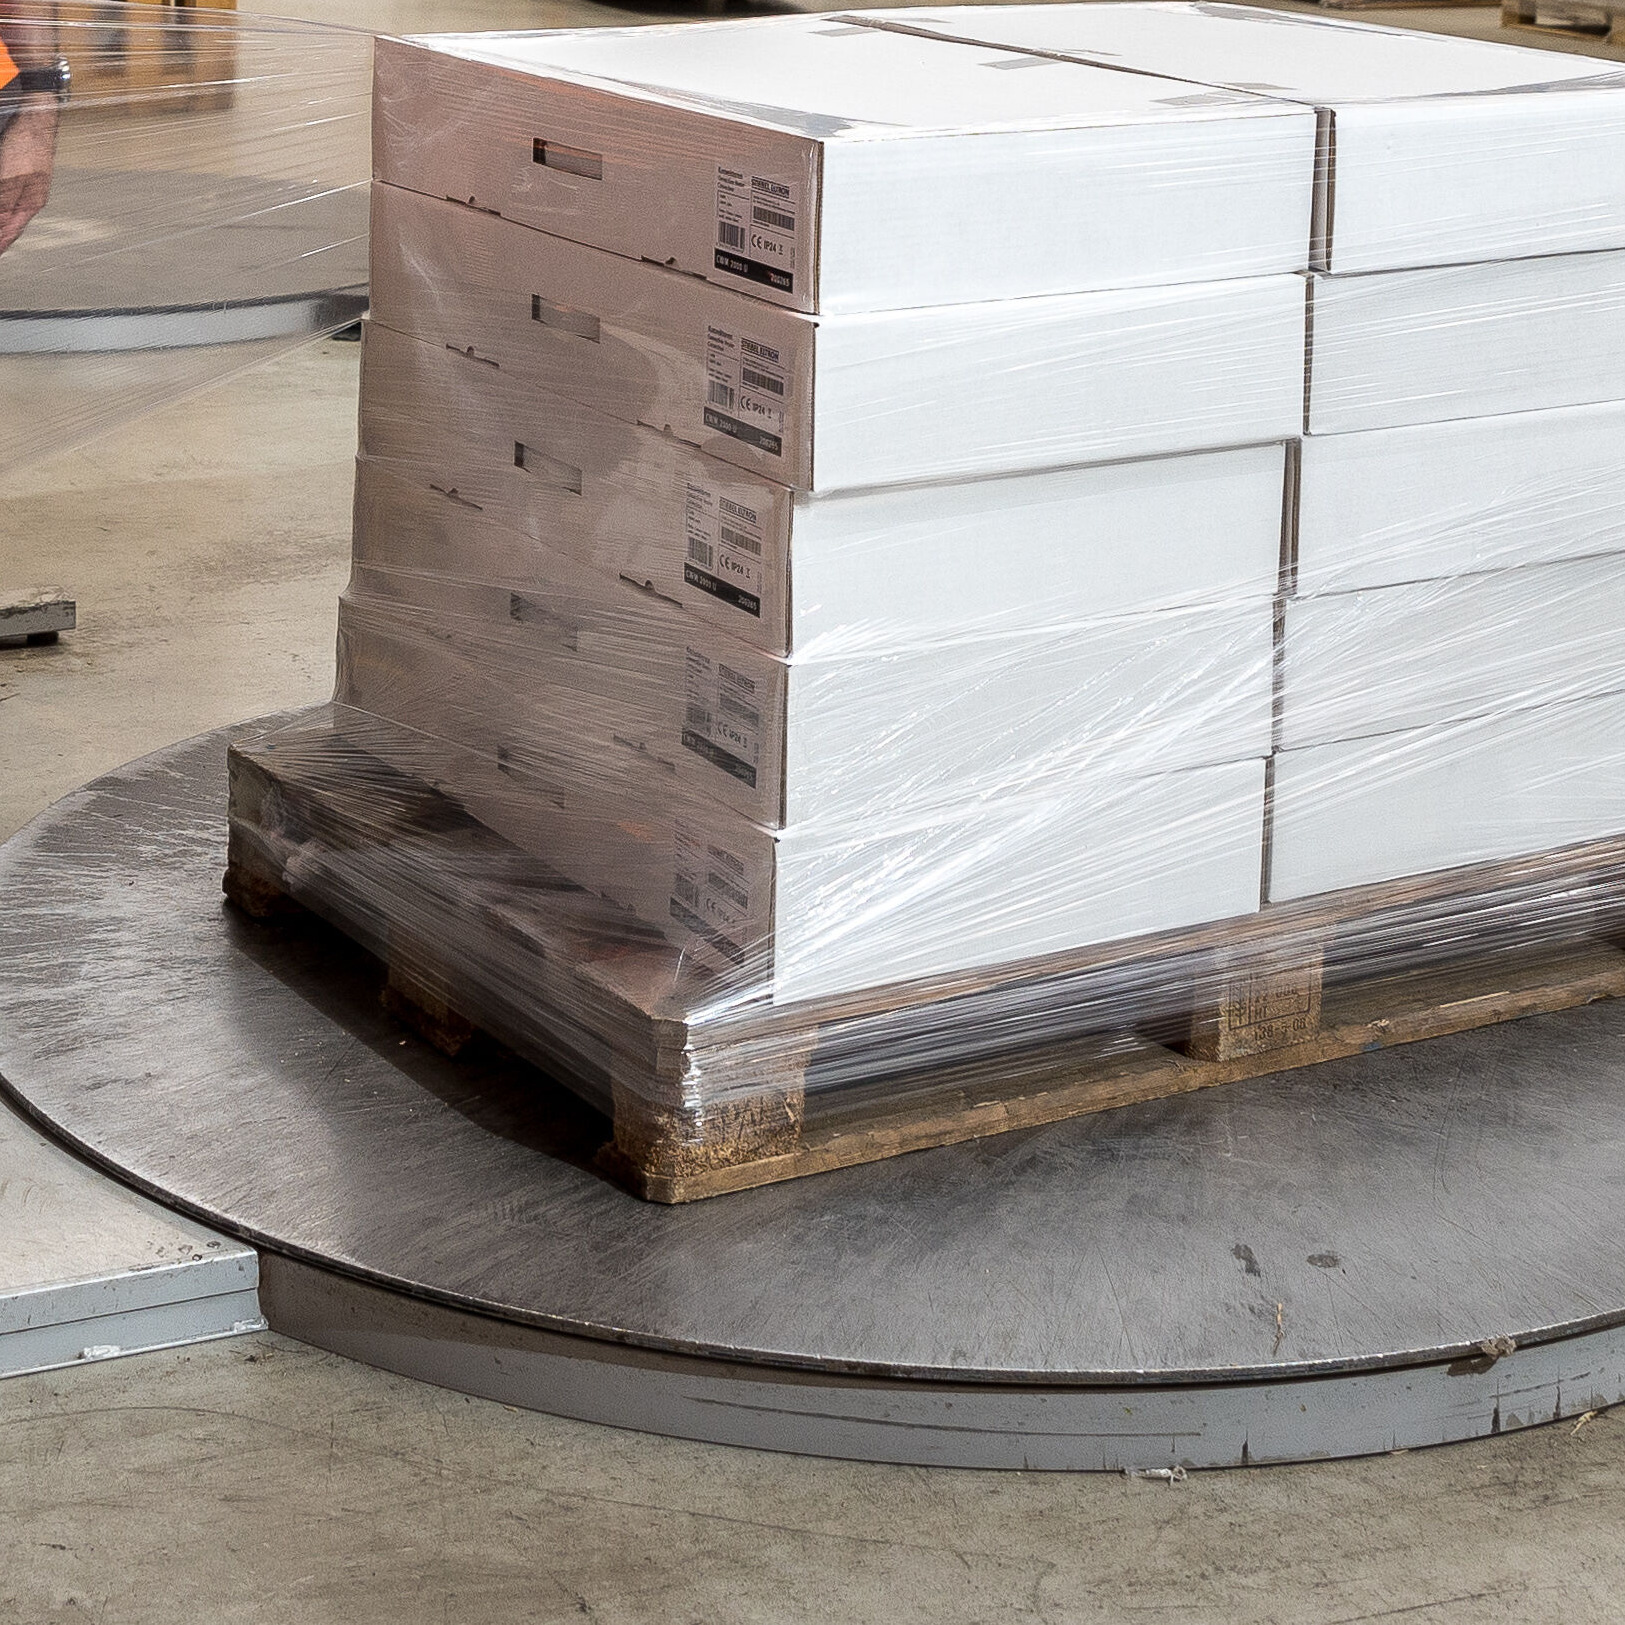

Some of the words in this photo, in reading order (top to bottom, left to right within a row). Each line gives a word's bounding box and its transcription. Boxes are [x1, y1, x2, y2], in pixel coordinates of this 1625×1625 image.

[764, 239, 777, 253] IP24
[753, 403, 765, 415] IP24
[731, 563, 743, 575] IP24
